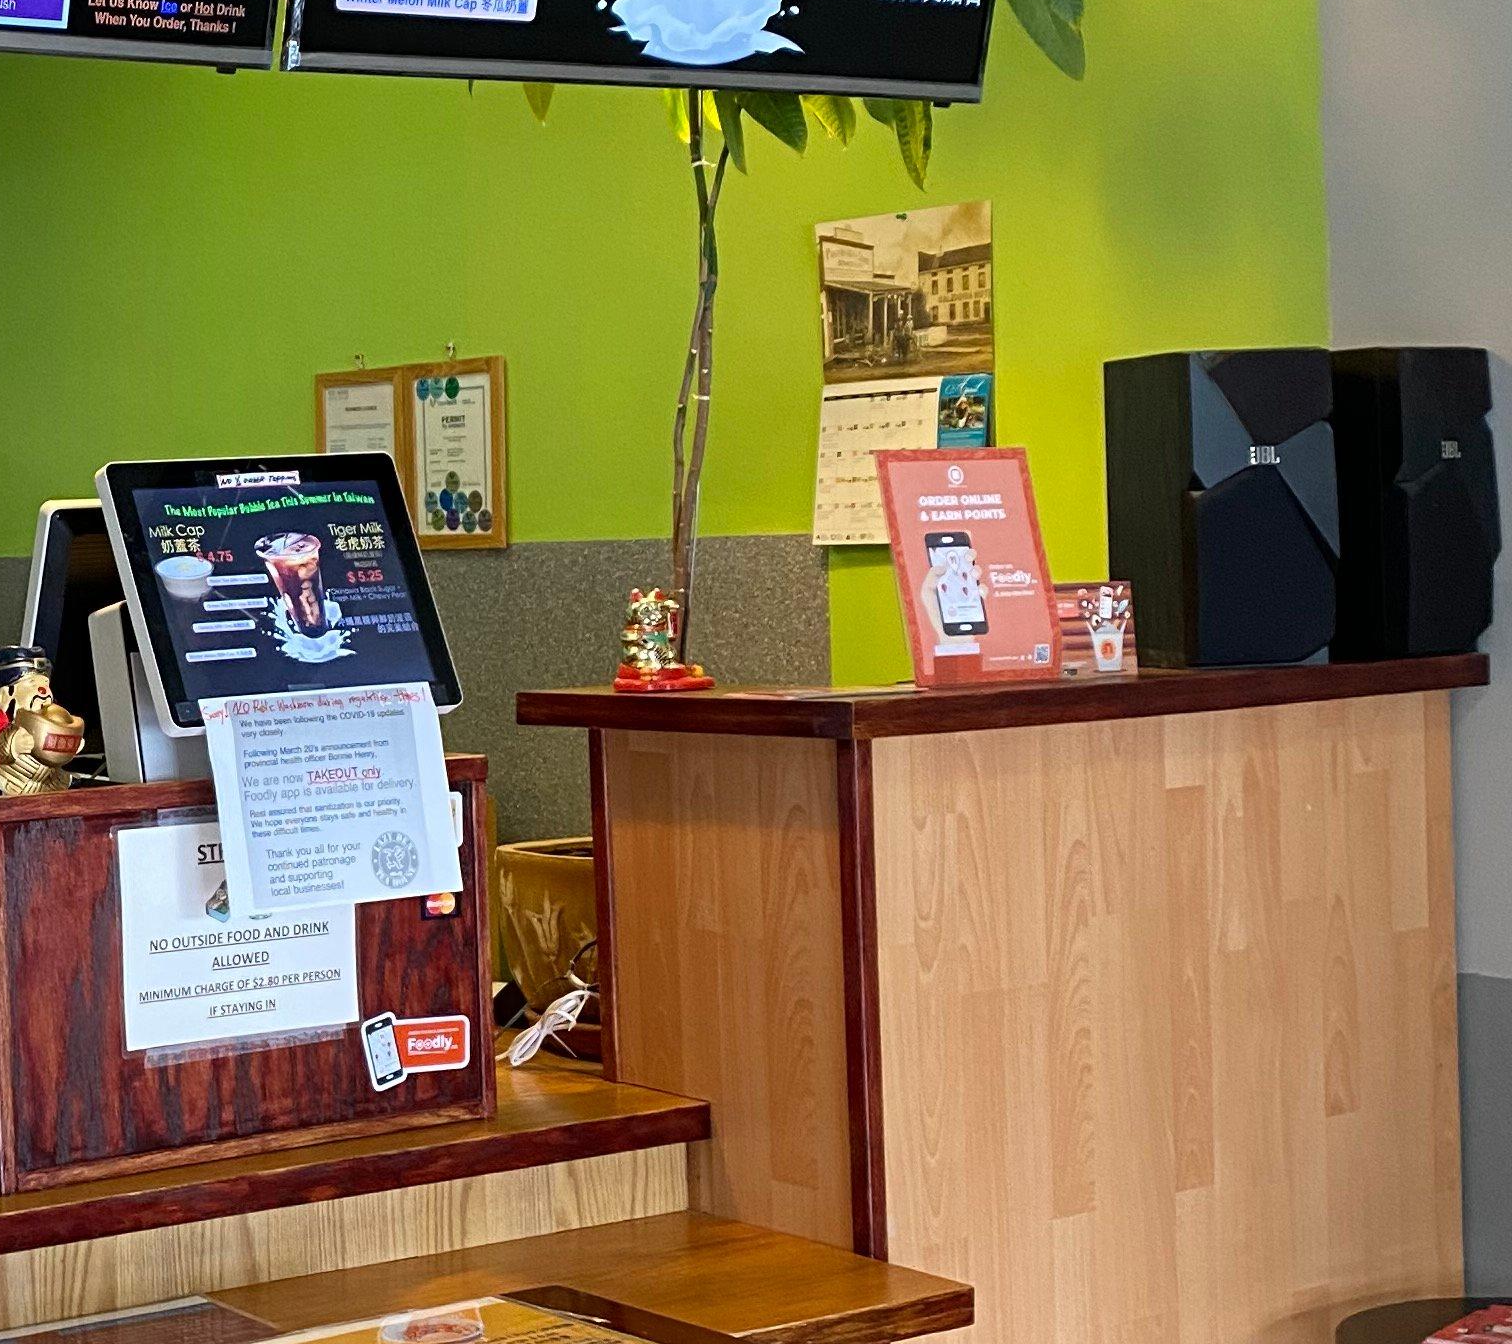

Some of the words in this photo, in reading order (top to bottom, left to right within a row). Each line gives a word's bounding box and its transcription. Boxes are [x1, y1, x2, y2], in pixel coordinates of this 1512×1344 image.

[181, 3, 191, 12] or
[194, 2, 214, 16] Hot
[217, 3, 245, 17] Drink
[1250, 446, 1280, 465] JBL
[918, 495, 958, 506] ORDER
[961, 494, 1002, 505] ONLINE
[149, 526, 174, 538] Milk
[176, 524, 204, 537] Cap
[327, 524, 357, 536] Tiger
[360, 523, 383, 534] Milk
[242, 776, 261, 788] We
[264, 777, 280, 786] are
[283, 773, 303, 784] now
[307, 767, 359, 782] TAKEOUT
[362, 766, 381, 780] only
[244, 788, 278, 802] Foodly
[281, 788, 300, 801] app
[303, 786, 312, 796] is
[315, 782, 358, 795] available
[362, 780, 374, 791] for
[377, 777, 414, 791] delivery
[150, 938, 168, 952] NO
[172, 933, 223, 948] OUTSIDE
[227, 929, 260, 944] FOOD
[264, 925, 290, 940] AND
[293, 921, 329, 936] DRINK
[213, 951, 269, 968] ALLOWED
[139, 985, 191, 1002] MINIMUM
[194, 981, 235, 996] CHARGE
[238, 979, 250, 989] OF
[253, 975, 279, 988] $2.80
[282, 973, 300, 985] PER
[303, 968, 340, 983] PERSON
[210, 1006, 217, 1016] IF
[220, 1001, 262, 1015] STAYING
[266, 999, 276, 1010] IN
[407, 1034, 453, 1053] Foodly
